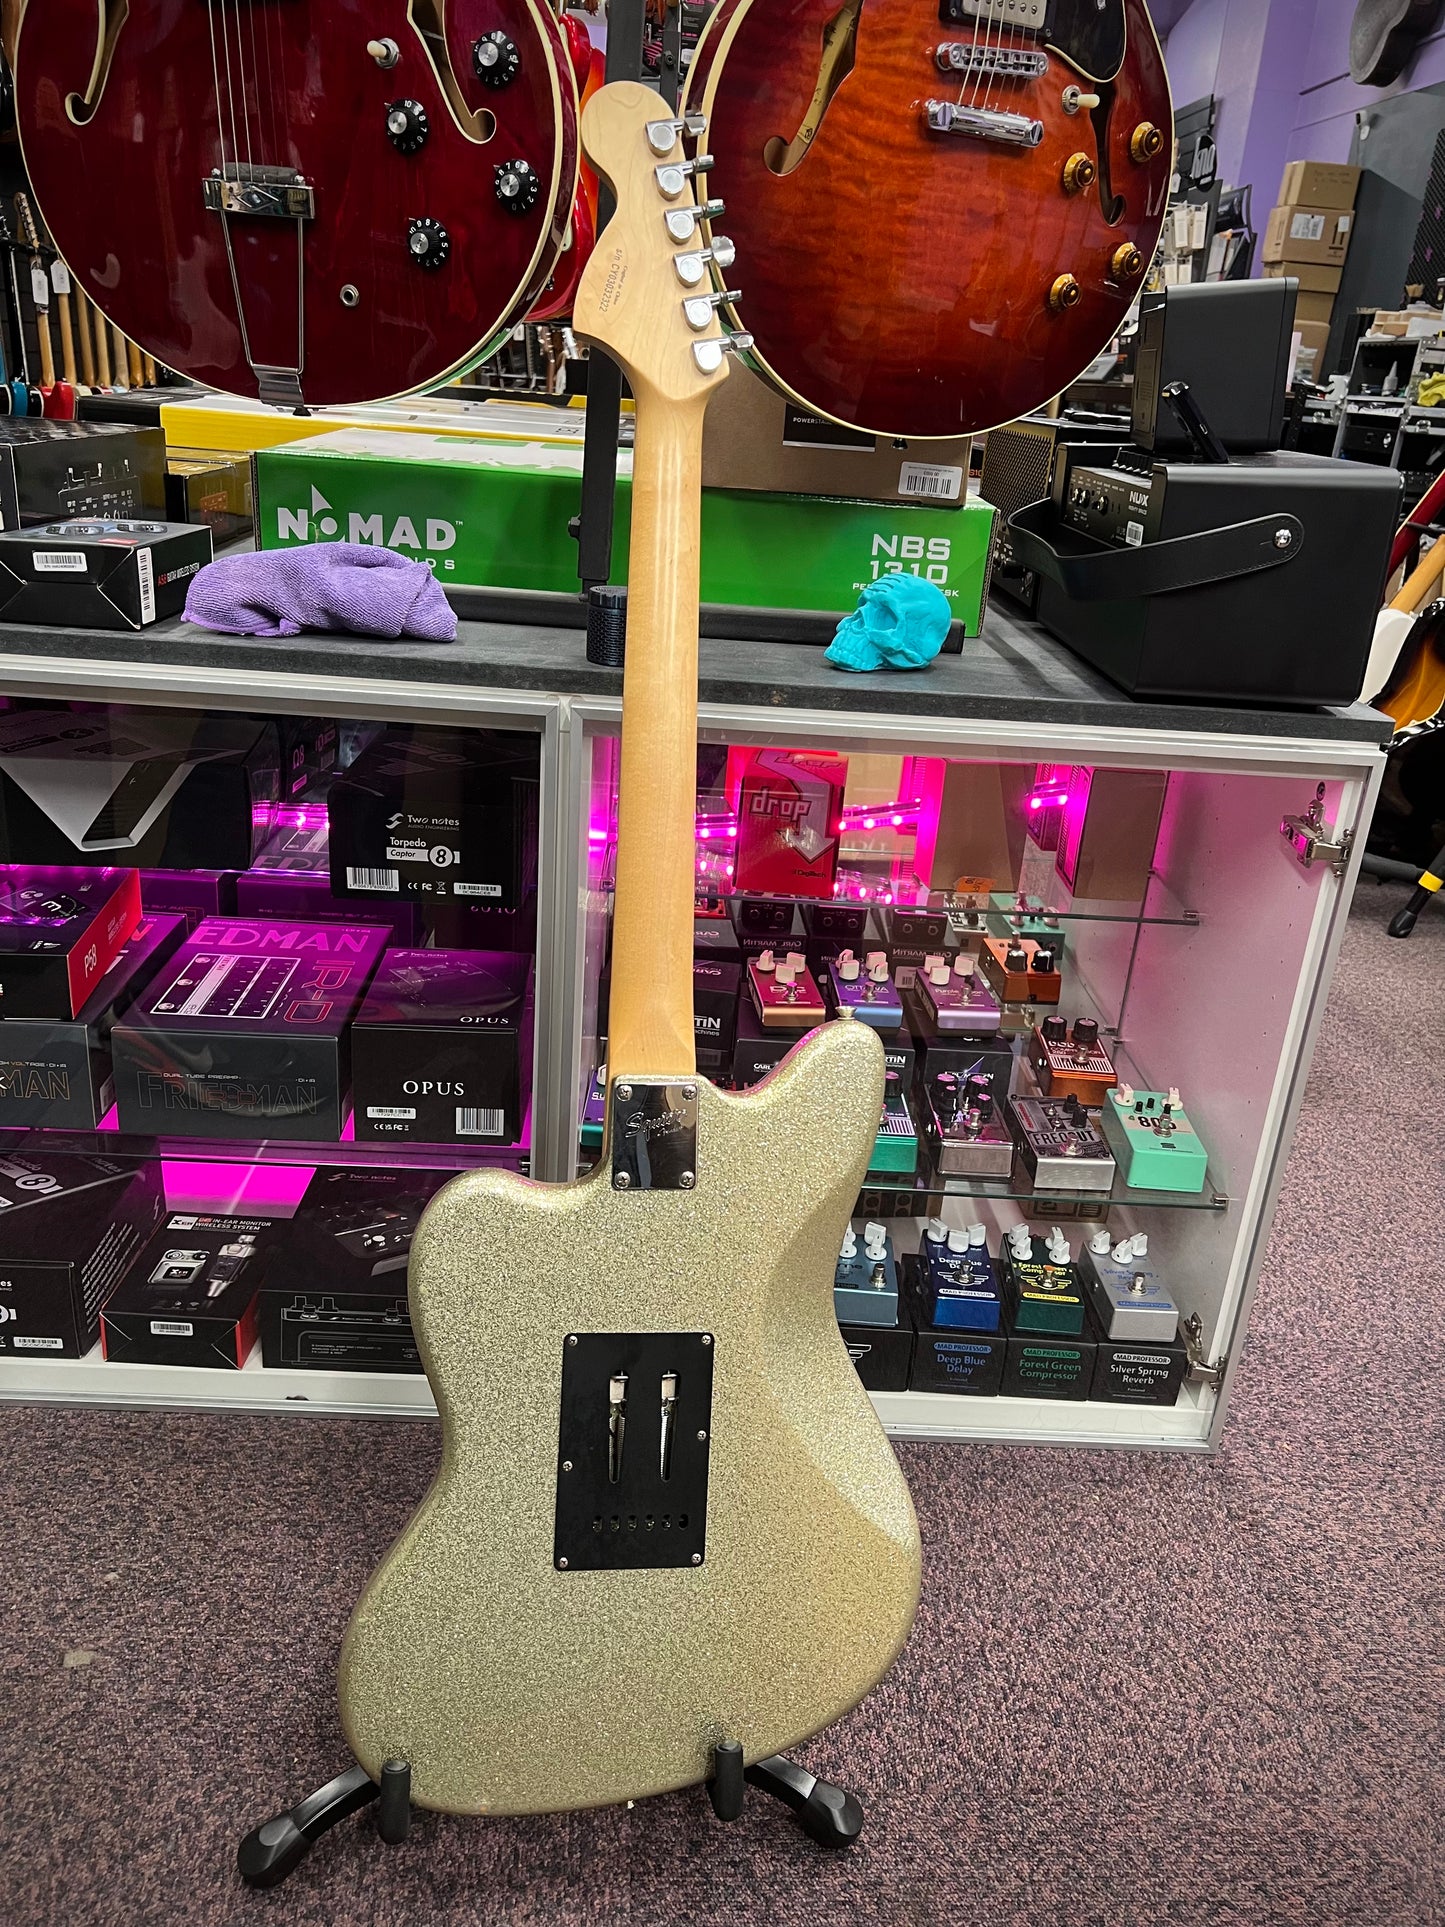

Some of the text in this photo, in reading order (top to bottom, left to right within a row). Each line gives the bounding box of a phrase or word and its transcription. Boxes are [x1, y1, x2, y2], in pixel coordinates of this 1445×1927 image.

[1129, 490, 1149, 507] NUX
[277, 497, 457, 551] NOMAD
[871, 533, 951, 561] NBS
[750, 786, 812, 822] drop
[407, 814, 460, 826] Two notes
[389, 836, 427, 848] Torpedo
[390, 849, 447, 865] Captor 8
[84, 943, 97, 979] P58
[459, 1016, 509, 1025] OPUS
[136, 1070, 318, 1116] FRIEDMAN
[402, 1080, 465, 1096] OPUS
[953, 1344, 989, 1352] PROFESSOR
[1042, 1350, 1078, 1358] PROFESSOR
[936, 1354, 986, 1366] Deep Blue
[1132, 1355, 1168, 1363] PROFESSOR
[946, 1364, 974, 1375] Delay
[1019, 1359, 1081, 1372] Forest Green
[1110, 1364, 1169, 1378] Silver Spring
[1019, 1369, 1078, 1380] Compressor
[1122, 1375, 1155, 1385] Reverb
